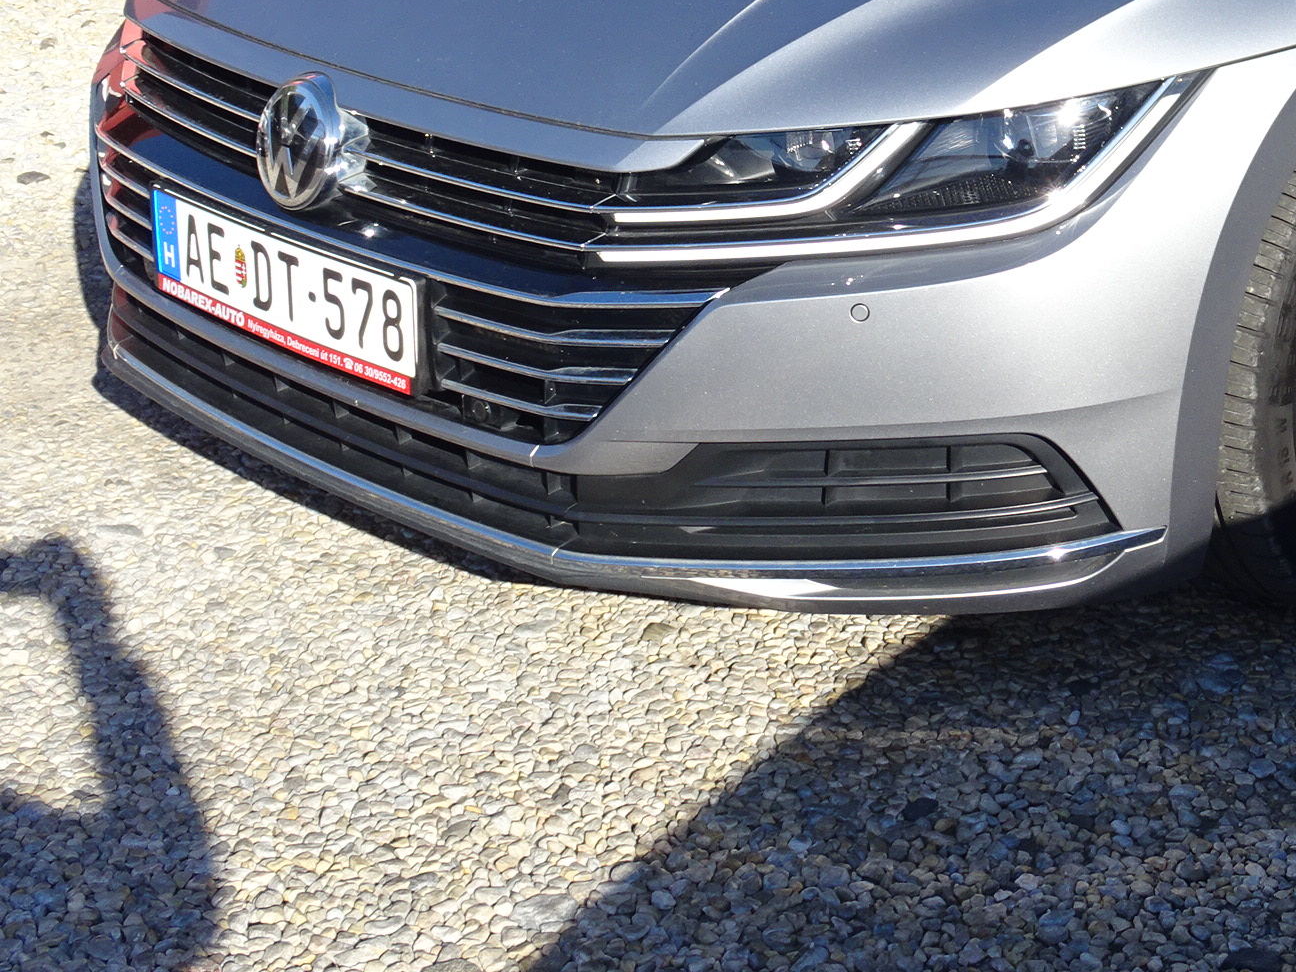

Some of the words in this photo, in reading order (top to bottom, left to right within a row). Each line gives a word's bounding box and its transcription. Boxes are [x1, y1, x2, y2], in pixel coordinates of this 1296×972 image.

[163, 241, 176, 269] H
[185, 214, 230, 296] AE
[162, 277, 245, 327] NOBAREX-AUTÓ
[247, 318, 287, 346] Nyíregyháza,
[286, 336, 320, 359] Debreceni
[328, 353, 344, 367] 151.
